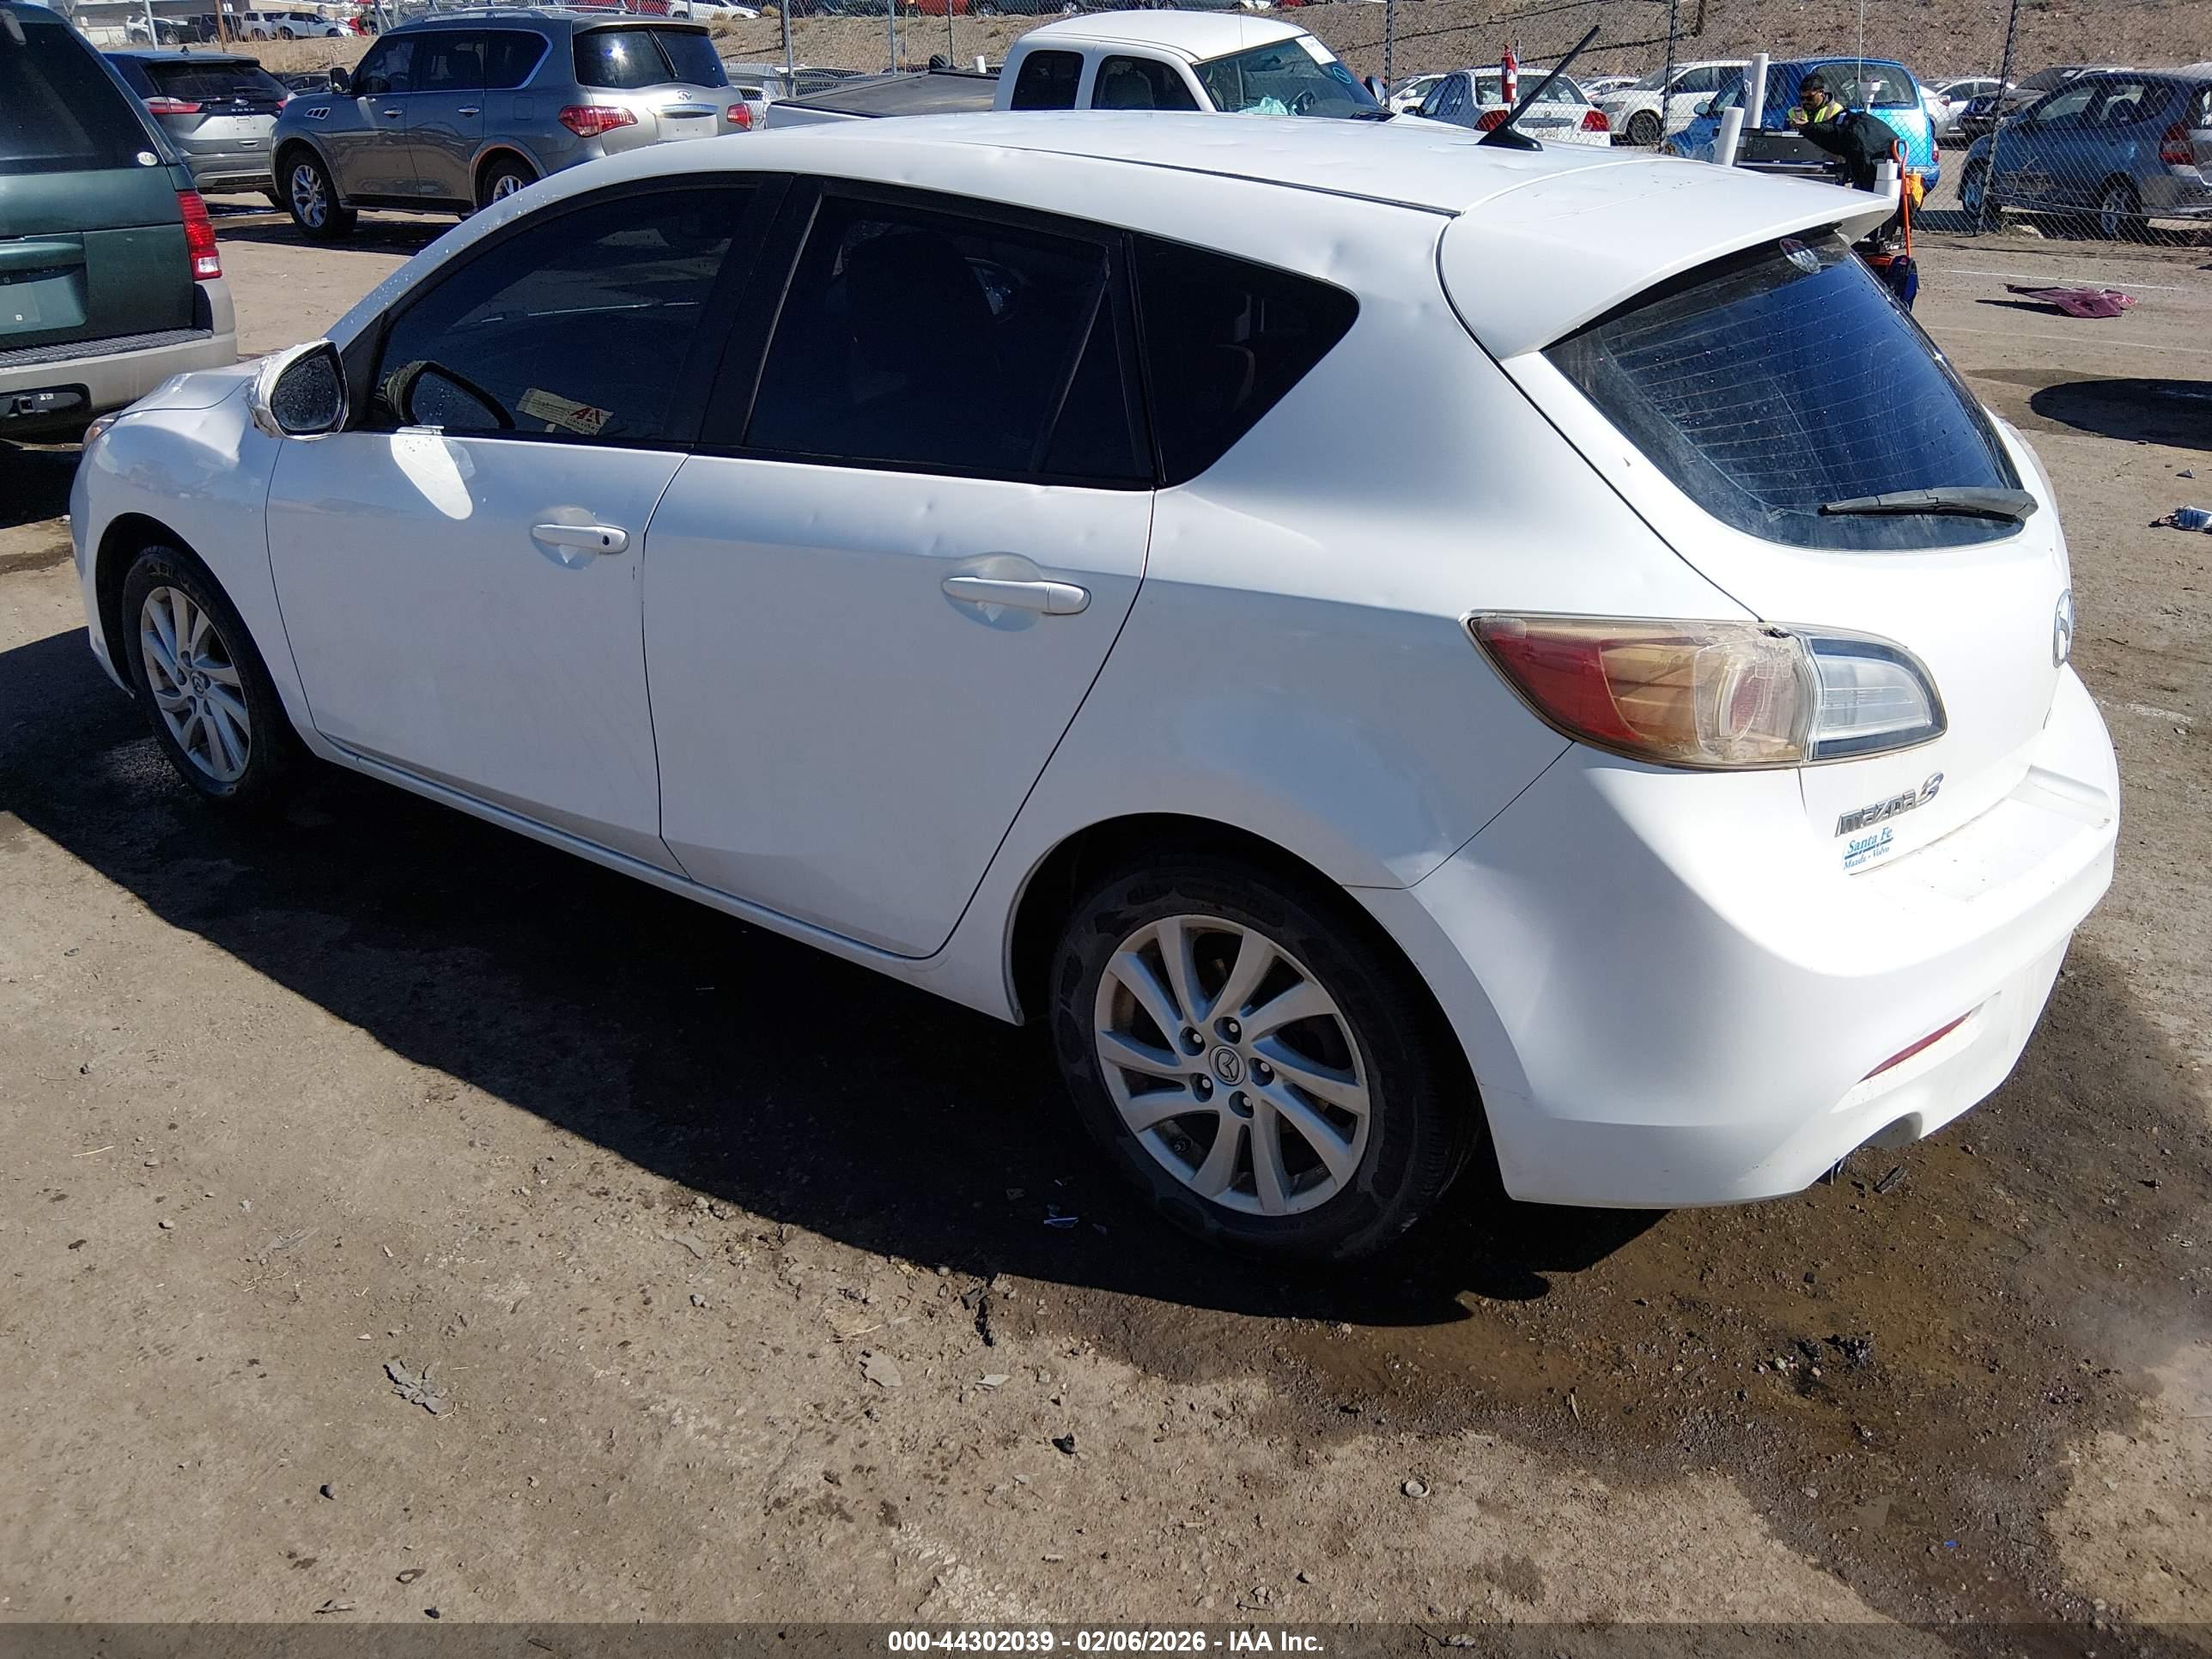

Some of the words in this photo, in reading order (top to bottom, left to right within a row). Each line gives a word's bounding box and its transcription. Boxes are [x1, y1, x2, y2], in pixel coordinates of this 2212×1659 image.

[1848, 835, 1878, 854] Santa
[1881, 826, 1893, 841] Fe
[1844, 854, 1867, 870] Mazda
[1873, 846, 1890, 857] Volvo
